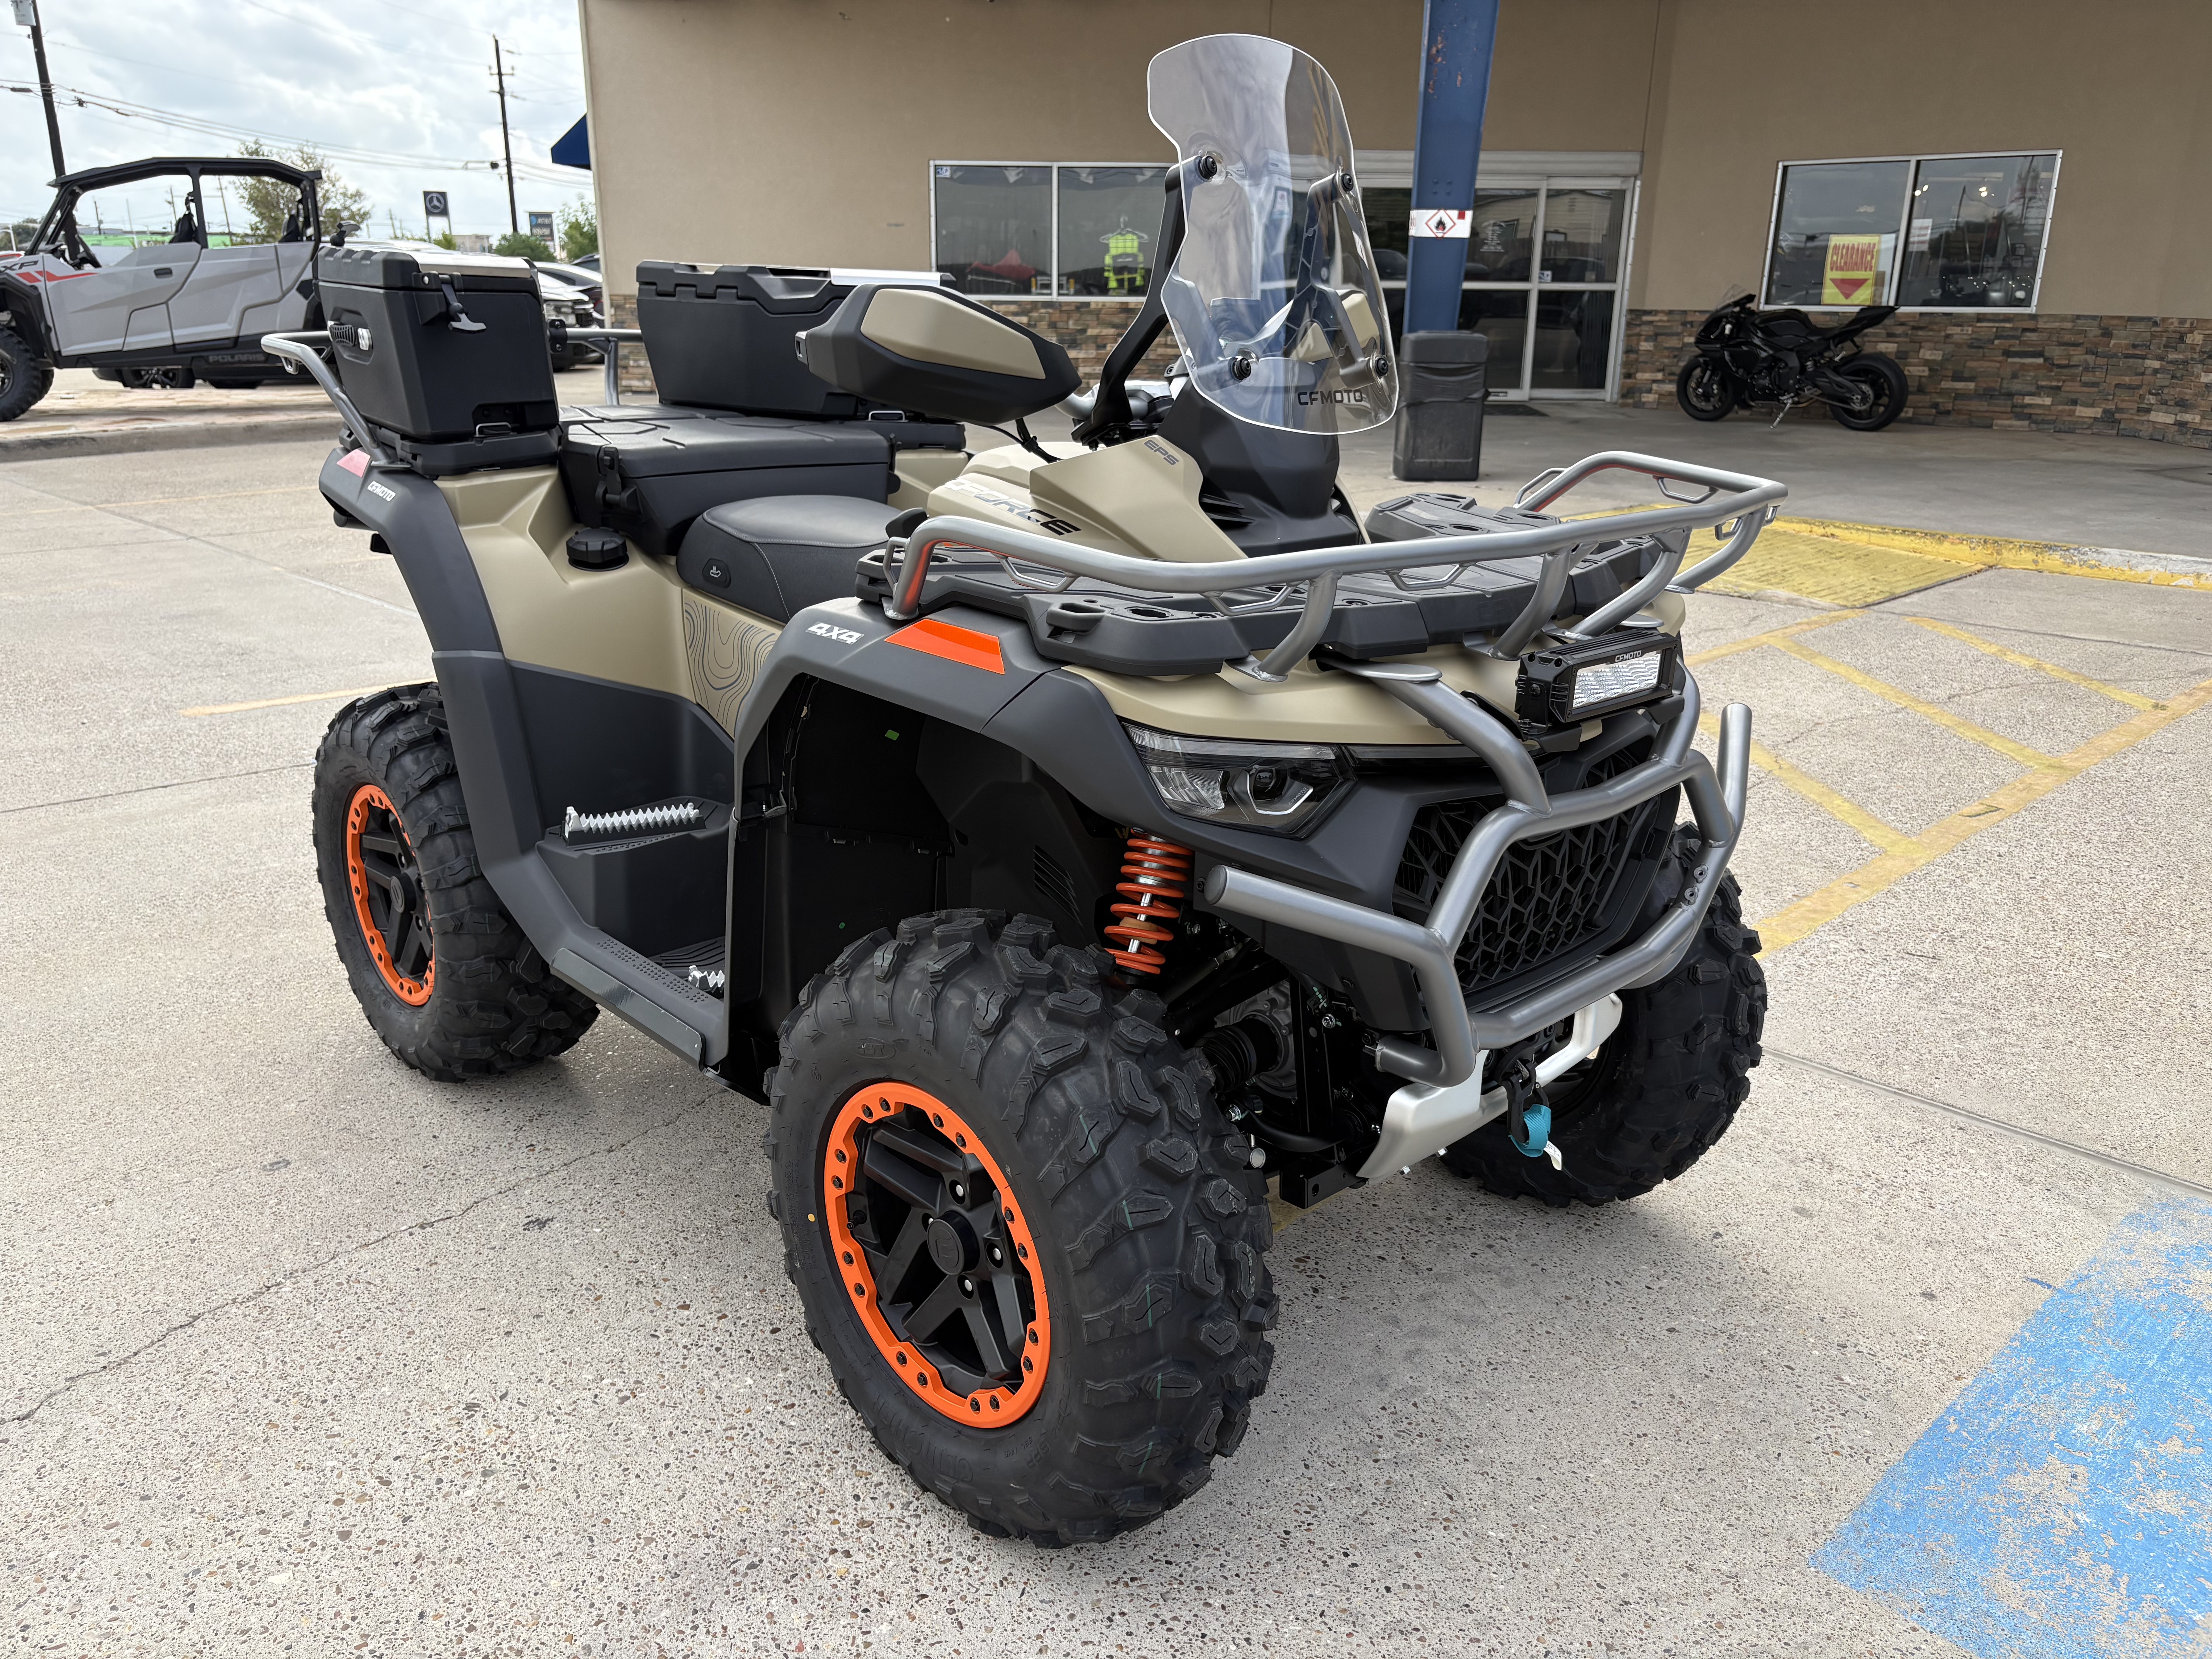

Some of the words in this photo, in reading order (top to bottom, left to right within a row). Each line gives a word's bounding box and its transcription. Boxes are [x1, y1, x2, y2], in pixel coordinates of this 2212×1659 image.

[1829, 242, 1876, 271] CLEARANCE
[0, 260, 39, 272] XP
[209, 353, 266, 362] POLARIS
[1298, 390, 1363, 405] CFMOTO
[1144, 440, 1179, 465] EPS
[367, 481, 396, 501] CFMOTO
[944, 478, 1082, 536] CFORCE
[1615, 651, 1641, 662] CFMOTO
[1288, 787, 1306, 805] CFMOTO
